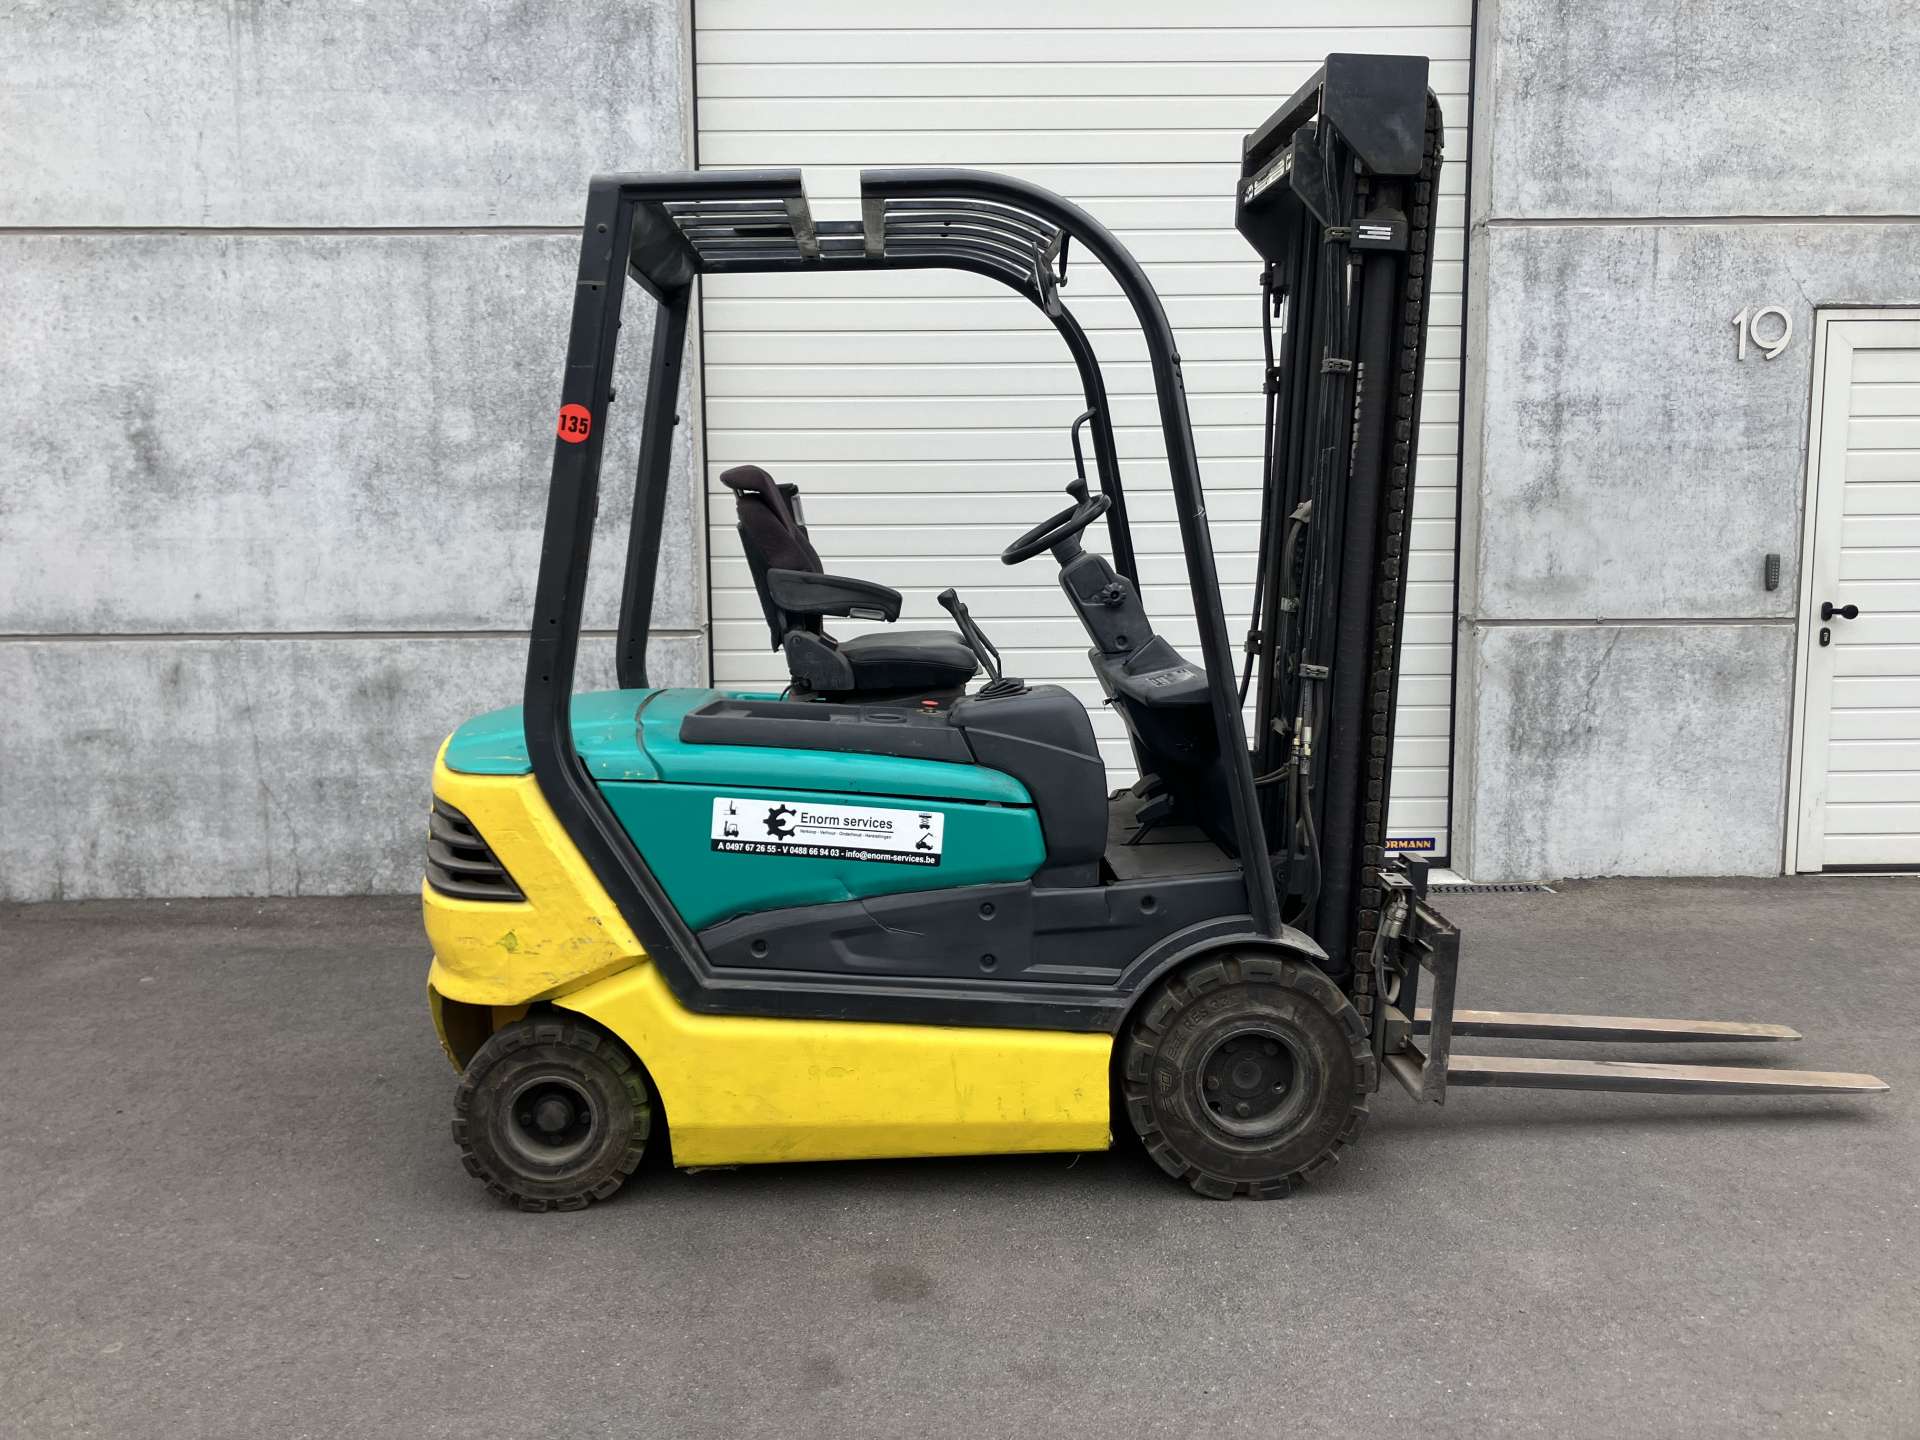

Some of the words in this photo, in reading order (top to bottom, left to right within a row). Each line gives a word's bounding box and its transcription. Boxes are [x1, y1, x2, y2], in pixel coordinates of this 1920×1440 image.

[1732, 305, 1793, 361] 19
[560, 414, 589, 435] 135
[800, 812, 840, 826] Enorm
[843, 816, 893, 830] services
[717, 842, 725, 850] A
[725, 843, 743, 851] 0497
[745, 843, 754, 851] 67
[756, 844, 765, 852] 26
[767, 845, 776, 853] 55
[782, 846, 789, 854] V
[789, 846, 807, 855] 0488
[809, 847, 818, 855] 66
[819, 848, 829, 856] 94
[830, 849, 840, 857] 03
[845, 850, 935, 864] info@enorm-services.be
